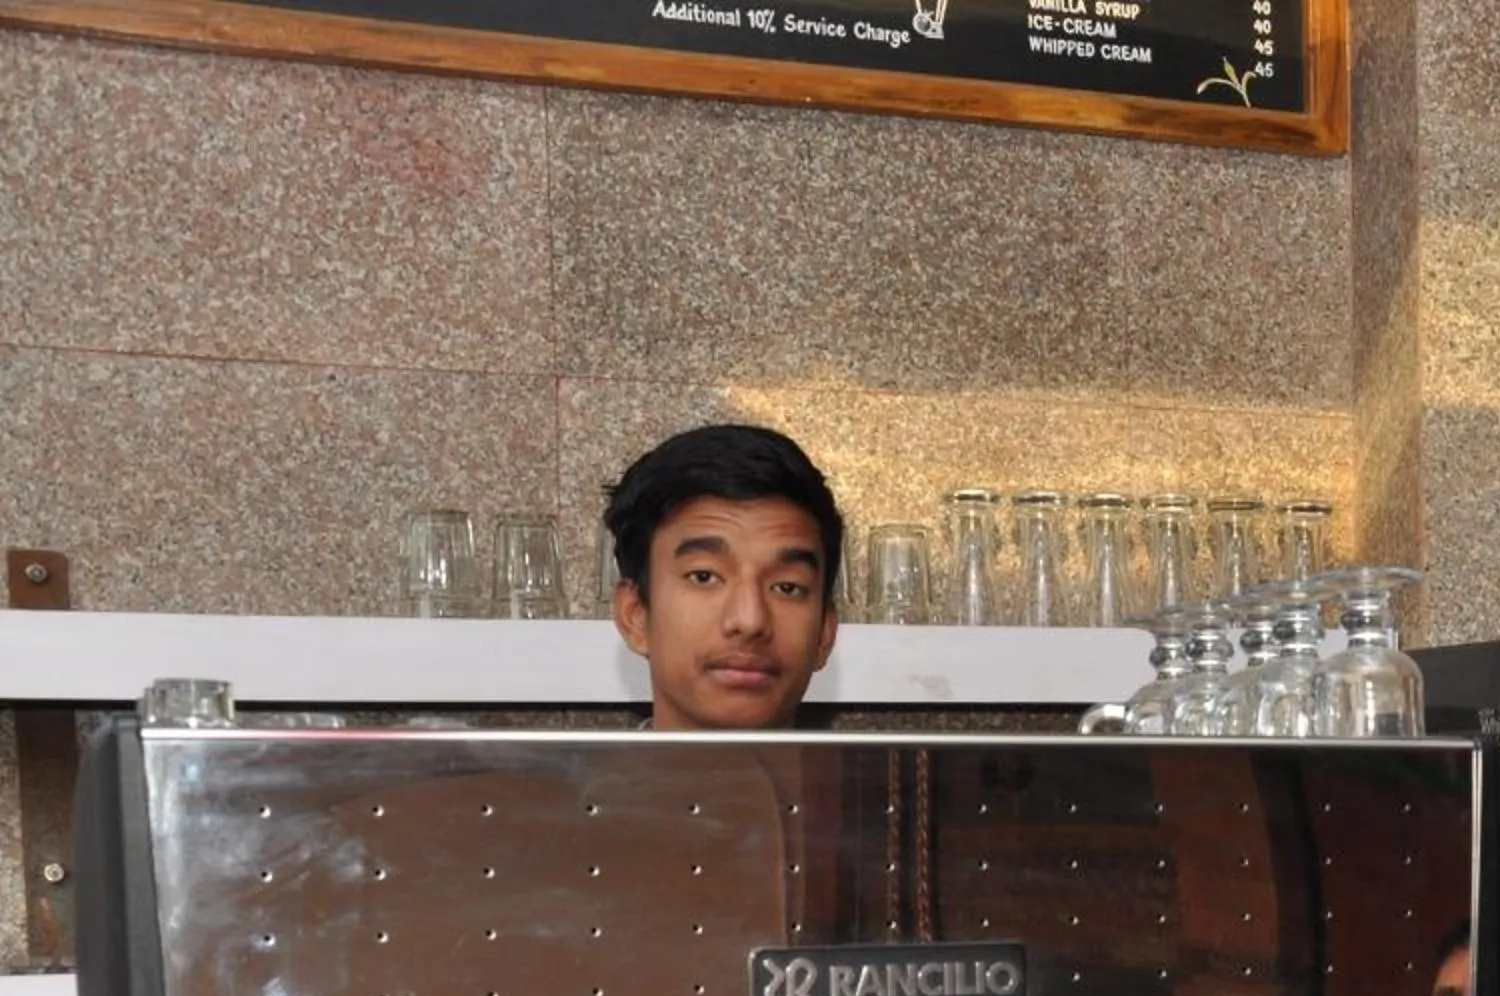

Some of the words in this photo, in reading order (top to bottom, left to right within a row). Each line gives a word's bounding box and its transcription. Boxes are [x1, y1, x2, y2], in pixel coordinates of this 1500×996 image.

[1095, 1, 1140, 20] SYRUP
[1253, 0, 1271, 15] 40
[652, 0, 741, 26] Additional
[747, 9, 776, 33] 10%
[784, 13, 847, 37] Service
[853, 21, 911, 48] Charge
[1253, 19, 1271, 34] 40
[1028, 35, 1095, 57] WHIPPED
[1101, 44, 1152, 63] CREAM
[1254, 39, 1274, 56] 45
[1255, 61, 1274, 78] 45
